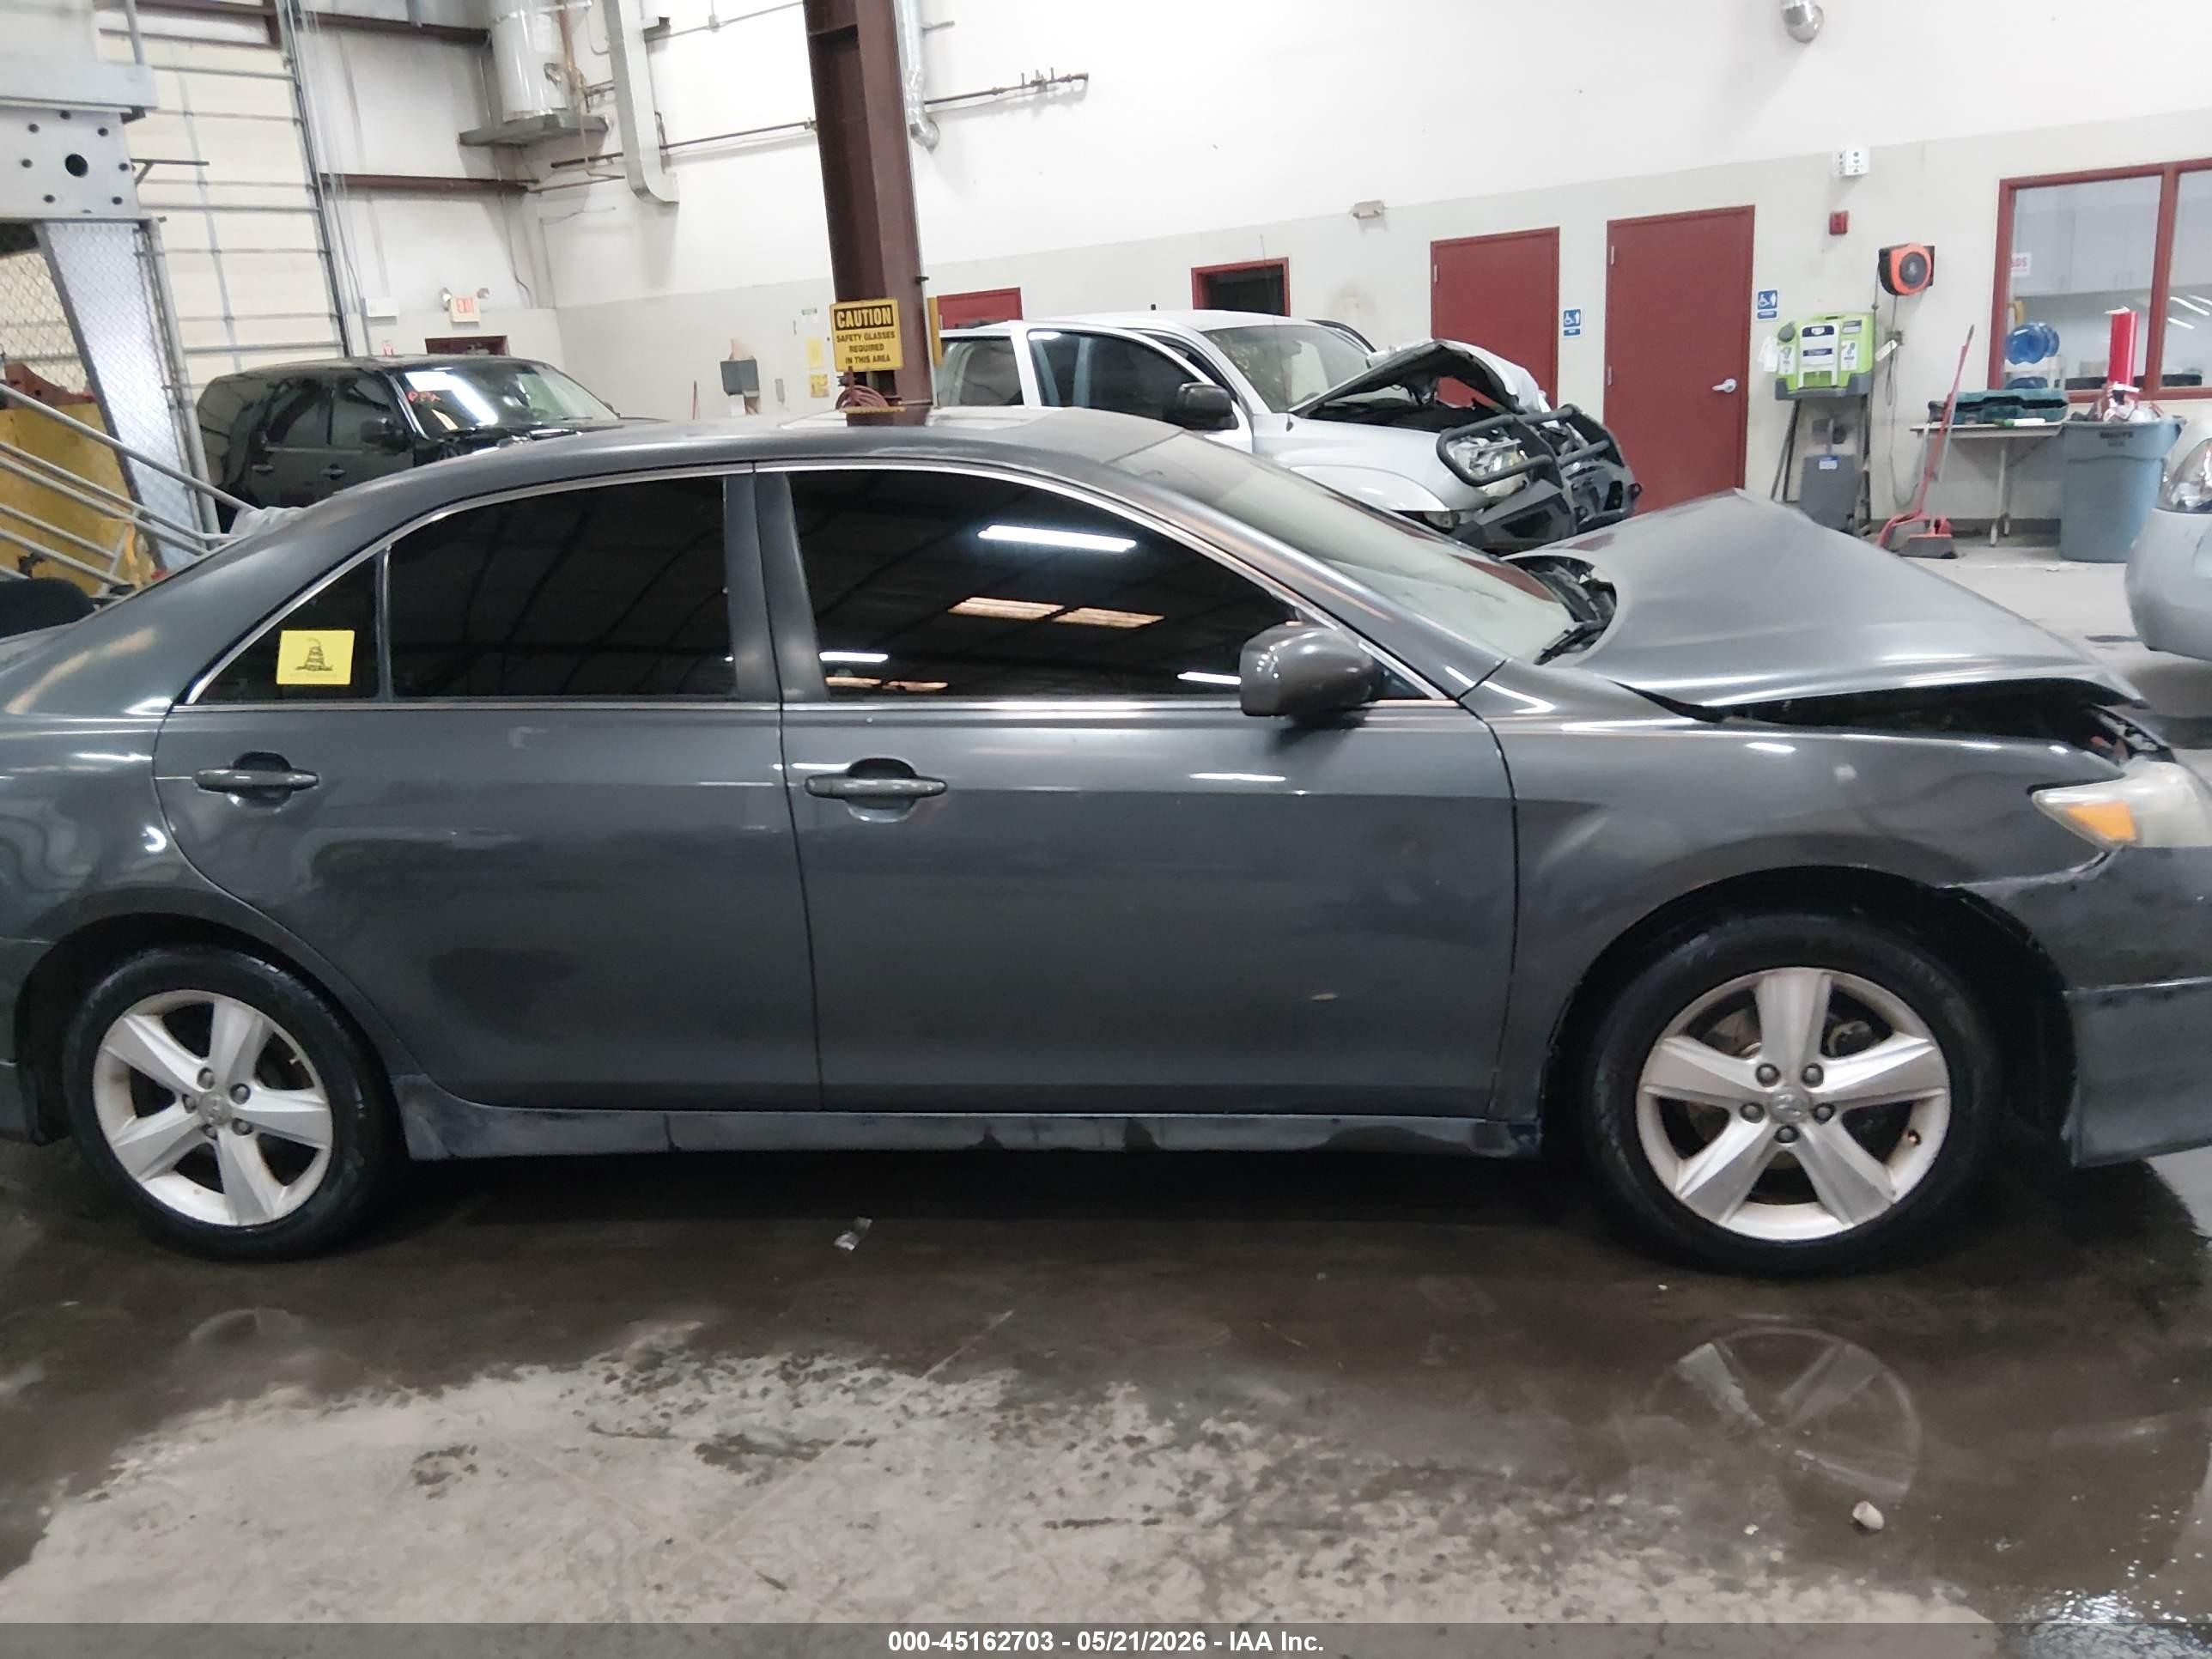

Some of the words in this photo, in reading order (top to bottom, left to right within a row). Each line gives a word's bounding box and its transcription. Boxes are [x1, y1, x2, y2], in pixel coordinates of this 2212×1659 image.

[836, 307, 891, 328] CAUTION
[836, 334, 861, 343] SAFETY
[864, 331, 895, 341] GLASSES
[848, 343, 884, 353] REQUIRED
[845, 356, 853, 365] IN
[854, 355, 871, 364] THIS
